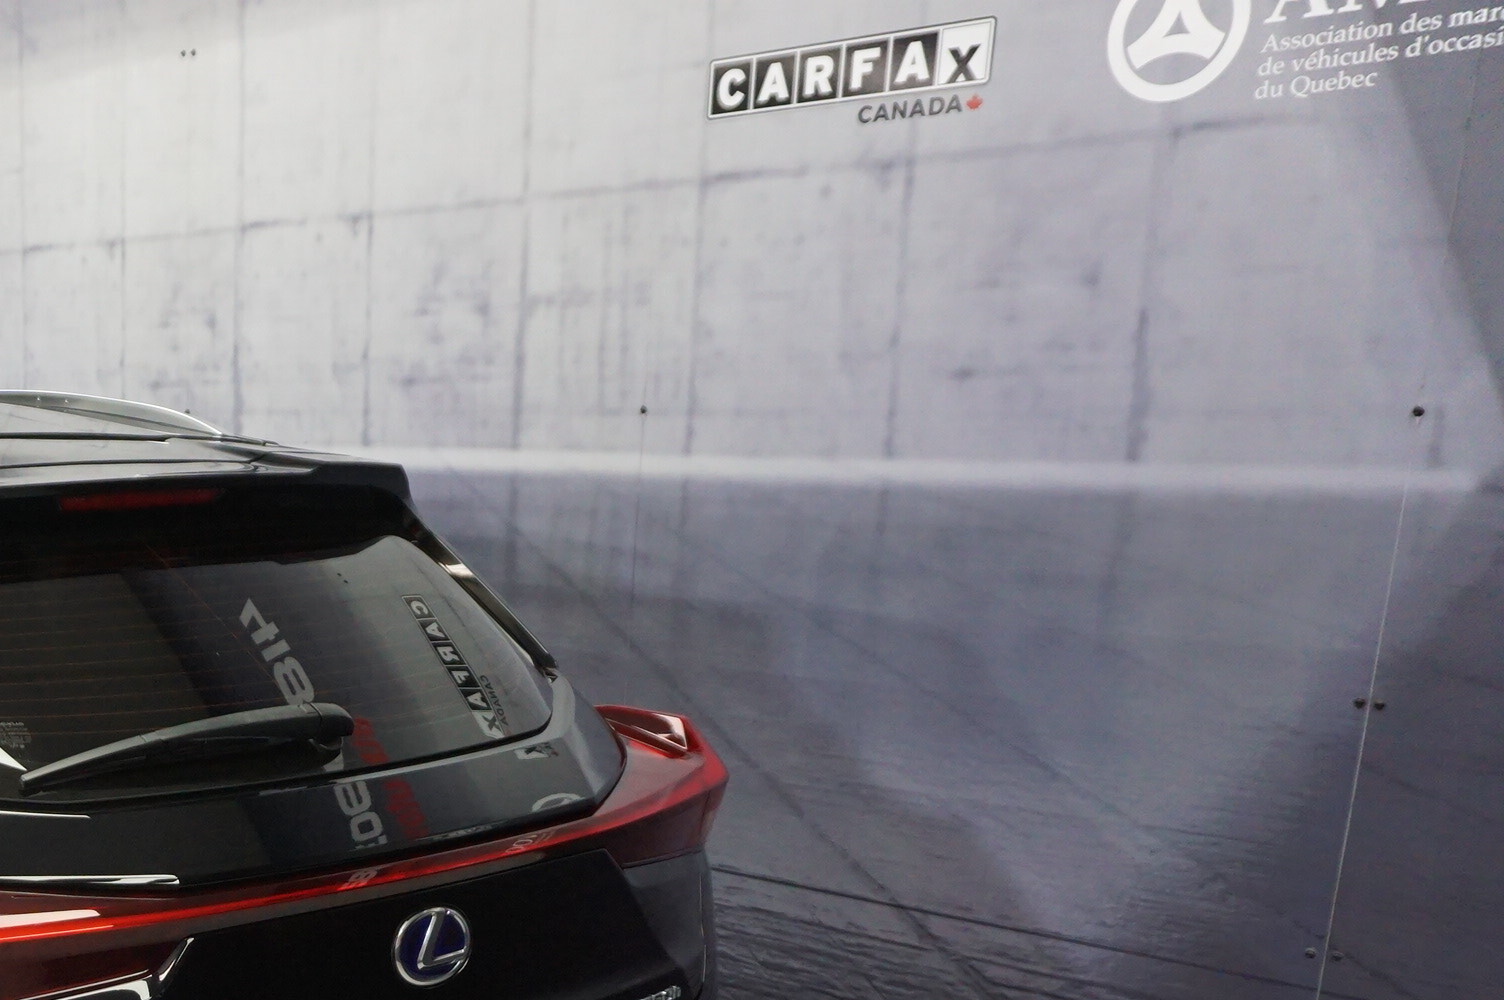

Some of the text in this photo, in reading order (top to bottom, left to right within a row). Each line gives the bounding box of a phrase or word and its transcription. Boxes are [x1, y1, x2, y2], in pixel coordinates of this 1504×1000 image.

[1259, 20, 1393, 54] Association
[1399, 12, 1443, 35] des
[714, 40, 983, 111] CARFAX
[1257, 56, 1285, 77] de
[1292, 42, 1399, 72] véhicules
[1255, 70, 1378, 100] du Quebec
[857, 94, 962, 124] CANADA
